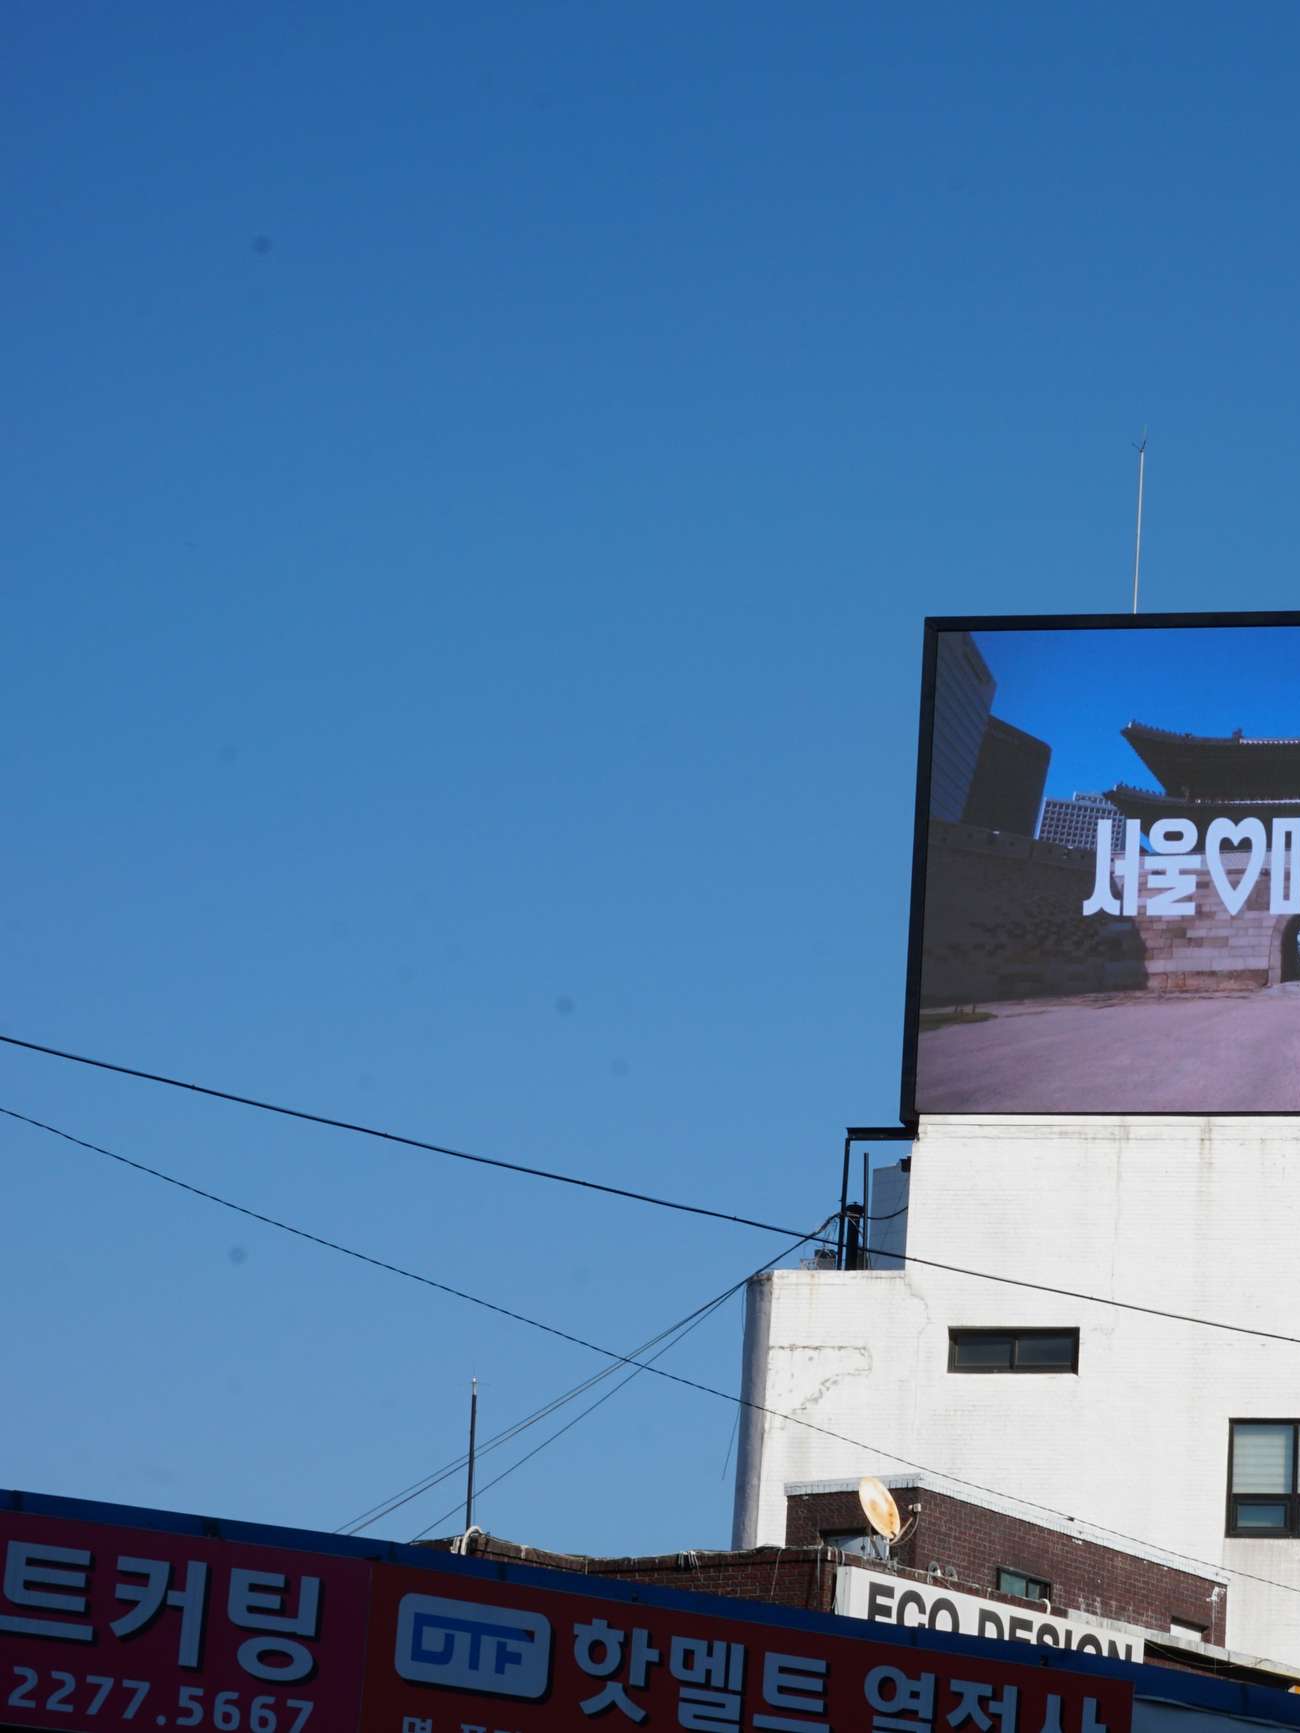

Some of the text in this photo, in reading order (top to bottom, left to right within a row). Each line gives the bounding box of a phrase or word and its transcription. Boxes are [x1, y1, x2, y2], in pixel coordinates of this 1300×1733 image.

[1083, 816, 1198, 916] 서울
[8, 1665, 315, 1733] 2277.5667
[572, 1618, 828, 1733] 핫멜트
